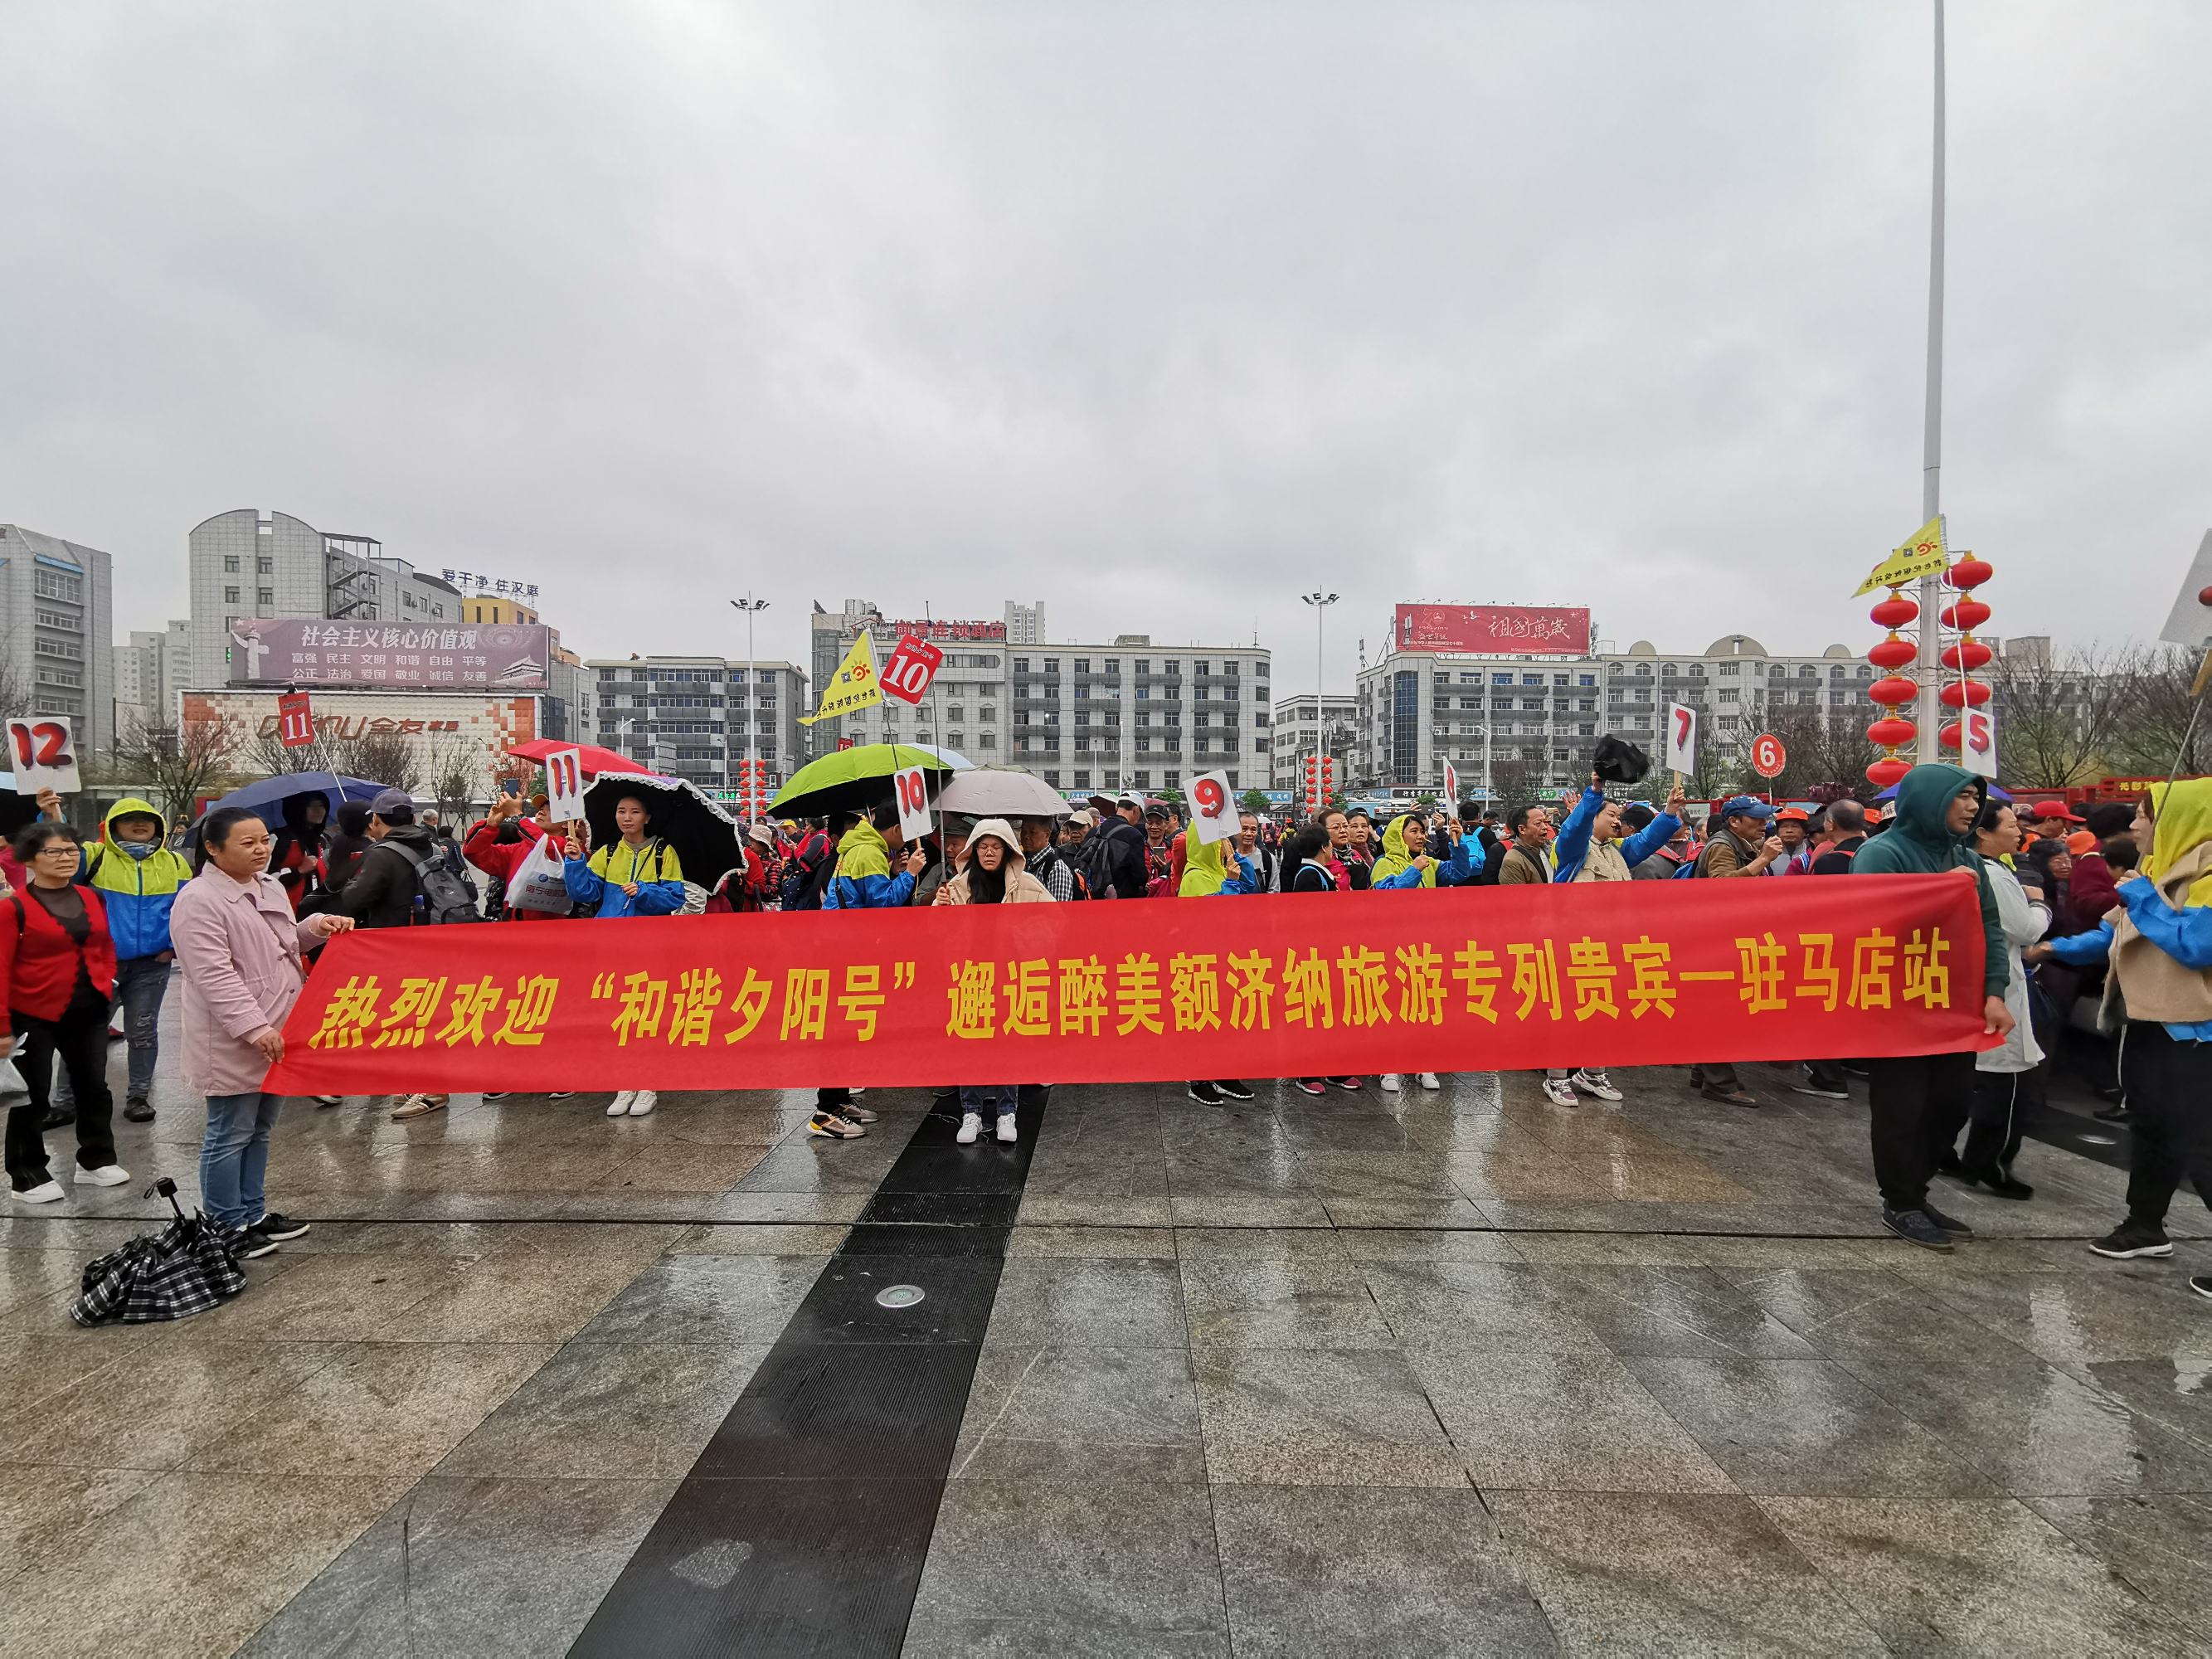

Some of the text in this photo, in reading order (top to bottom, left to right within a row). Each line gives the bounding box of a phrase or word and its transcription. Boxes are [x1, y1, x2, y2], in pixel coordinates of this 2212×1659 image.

[442, 569, 539, 596] 爱干净 住汉庭
[300, 625, 478, 650] 社会主义核心价值观
[291, 653, 487, 667] 富强 民主 文明 和谐 自由 平等
[292, 668, 488, 682] 公正 法治 爱国 敬业 诚信 友善
[883, 654, 929, 693] 10
[10, 722, 73, 770] 12
[285, 713, 310, 740] 11
[1675, 708, 1692, 751] 7
[1968, 713, 1989, 754] 5
[1759, 741, 1776, 767] 6
[550, 754, 576, 800] 11
[896, 771, 925, 818] 10
[1194, 778, 1225, 818] 9
